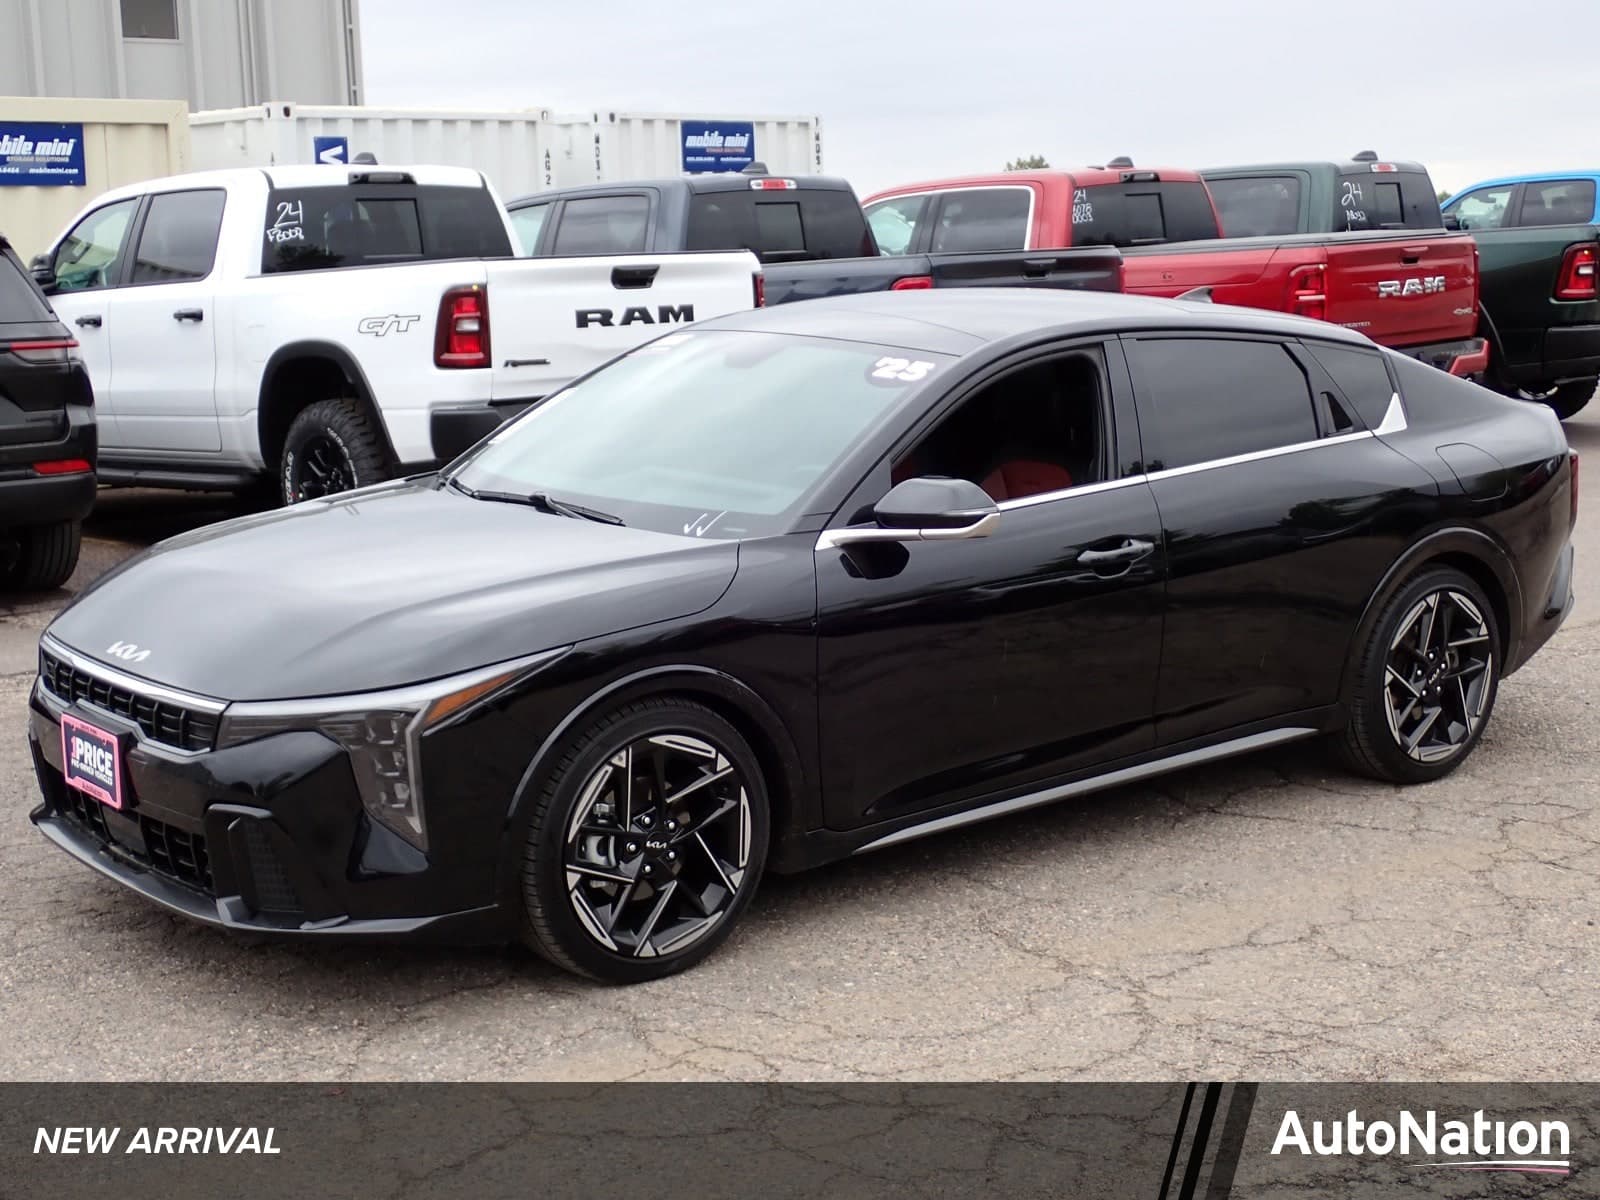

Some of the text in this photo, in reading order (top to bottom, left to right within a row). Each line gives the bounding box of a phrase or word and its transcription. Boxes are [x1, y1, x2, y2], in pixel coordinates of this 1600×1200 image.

[0, 134, 75, 156] bile mini
[685, 130, 750, 148] mobile mini
[1073, 189, 1086, 202] 24
[1341, 181, 1363, 207] 24
[274, 200, 303, 228] 24
[1378, 276, 1445, 298] RAM
[575, 304, 694, 328] RAM
[872, 356, 936, 381] 25
